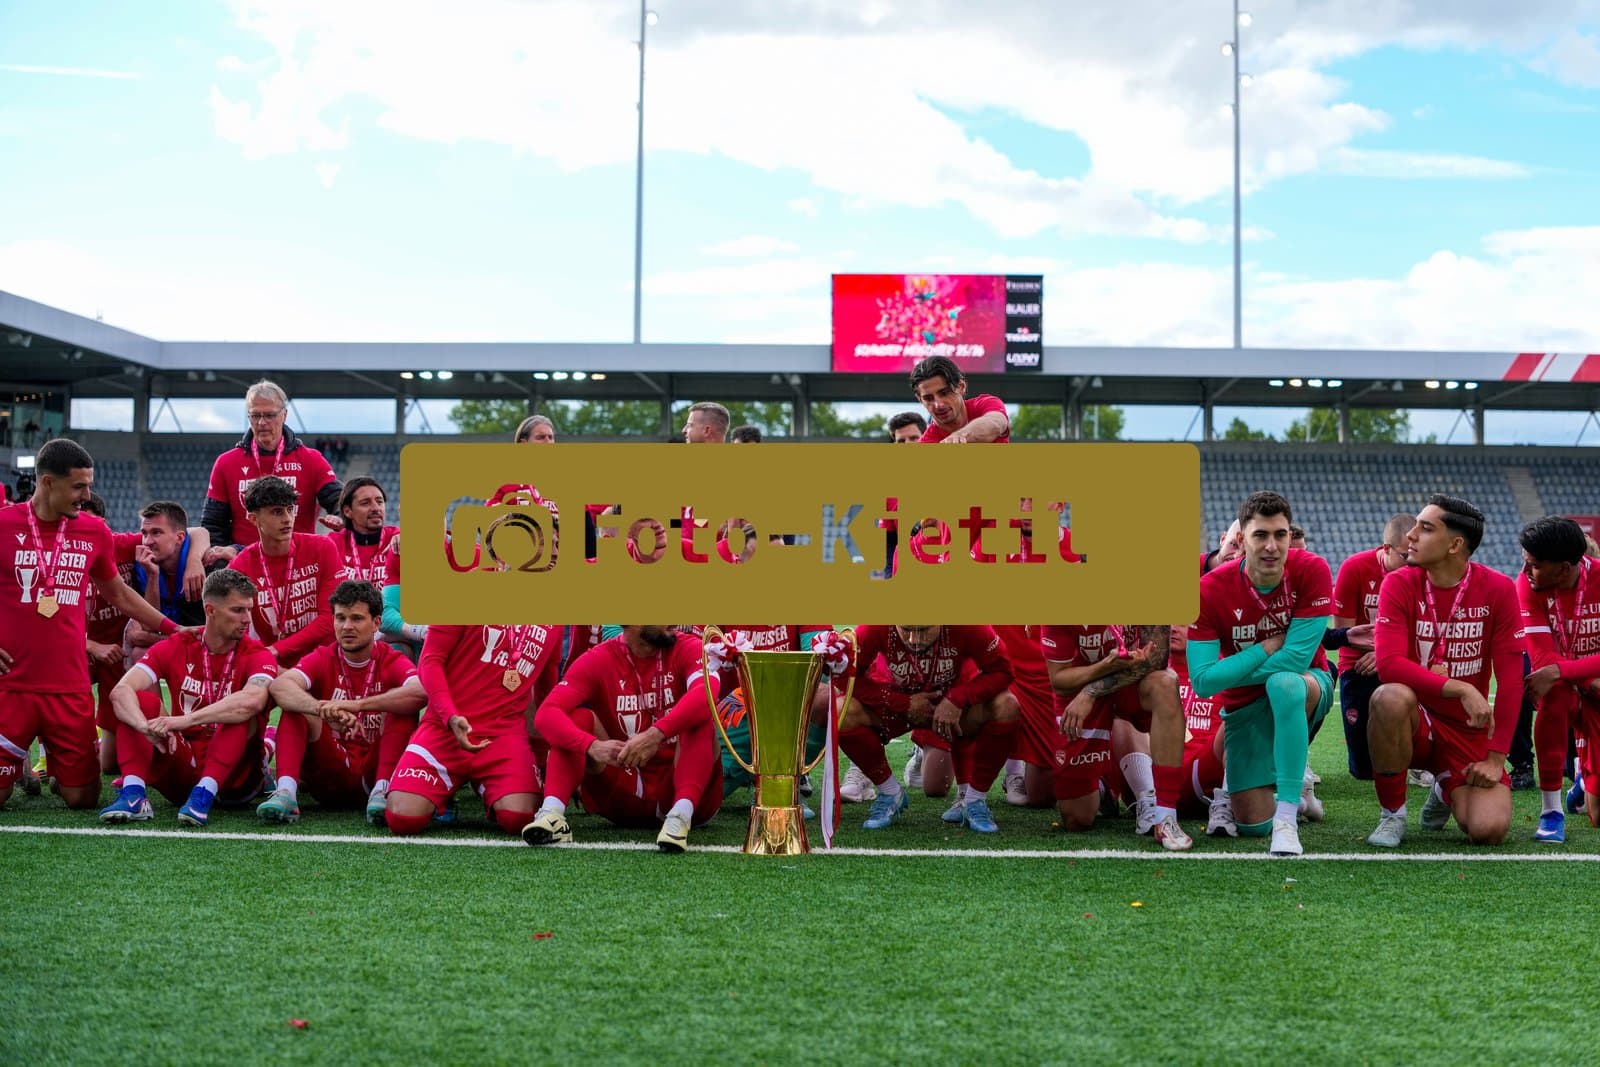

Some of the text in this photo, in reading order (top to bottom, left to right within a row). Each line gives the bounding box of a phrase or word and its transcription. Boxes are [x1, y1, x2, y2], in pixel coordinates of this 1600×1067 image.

[284, 462, 302, 471] UBS
[73, 540, 93, 552] UBS
[301, 563, 319, 577] UBS
[257, 590, 272, 606] DE
[291, 594, 317, 615] HEISST
[1364, 593, 1379, 606] DE
[1467, 606, 1490, 618] UBS
[284, 619, 298, 634] FC
[1232, 624, 1256, 640] DER
[1079, 633, 1101, 648] DER
[1447, 640, 1483, 658] HEISST
[493, 650, 509, 667] FC
[181, 675, 201, 695] DER
[616, 695, 638, 712] DER
[1070, 750, 1111, 766] UXAN
[398, 767, 438, 786] UXAN
